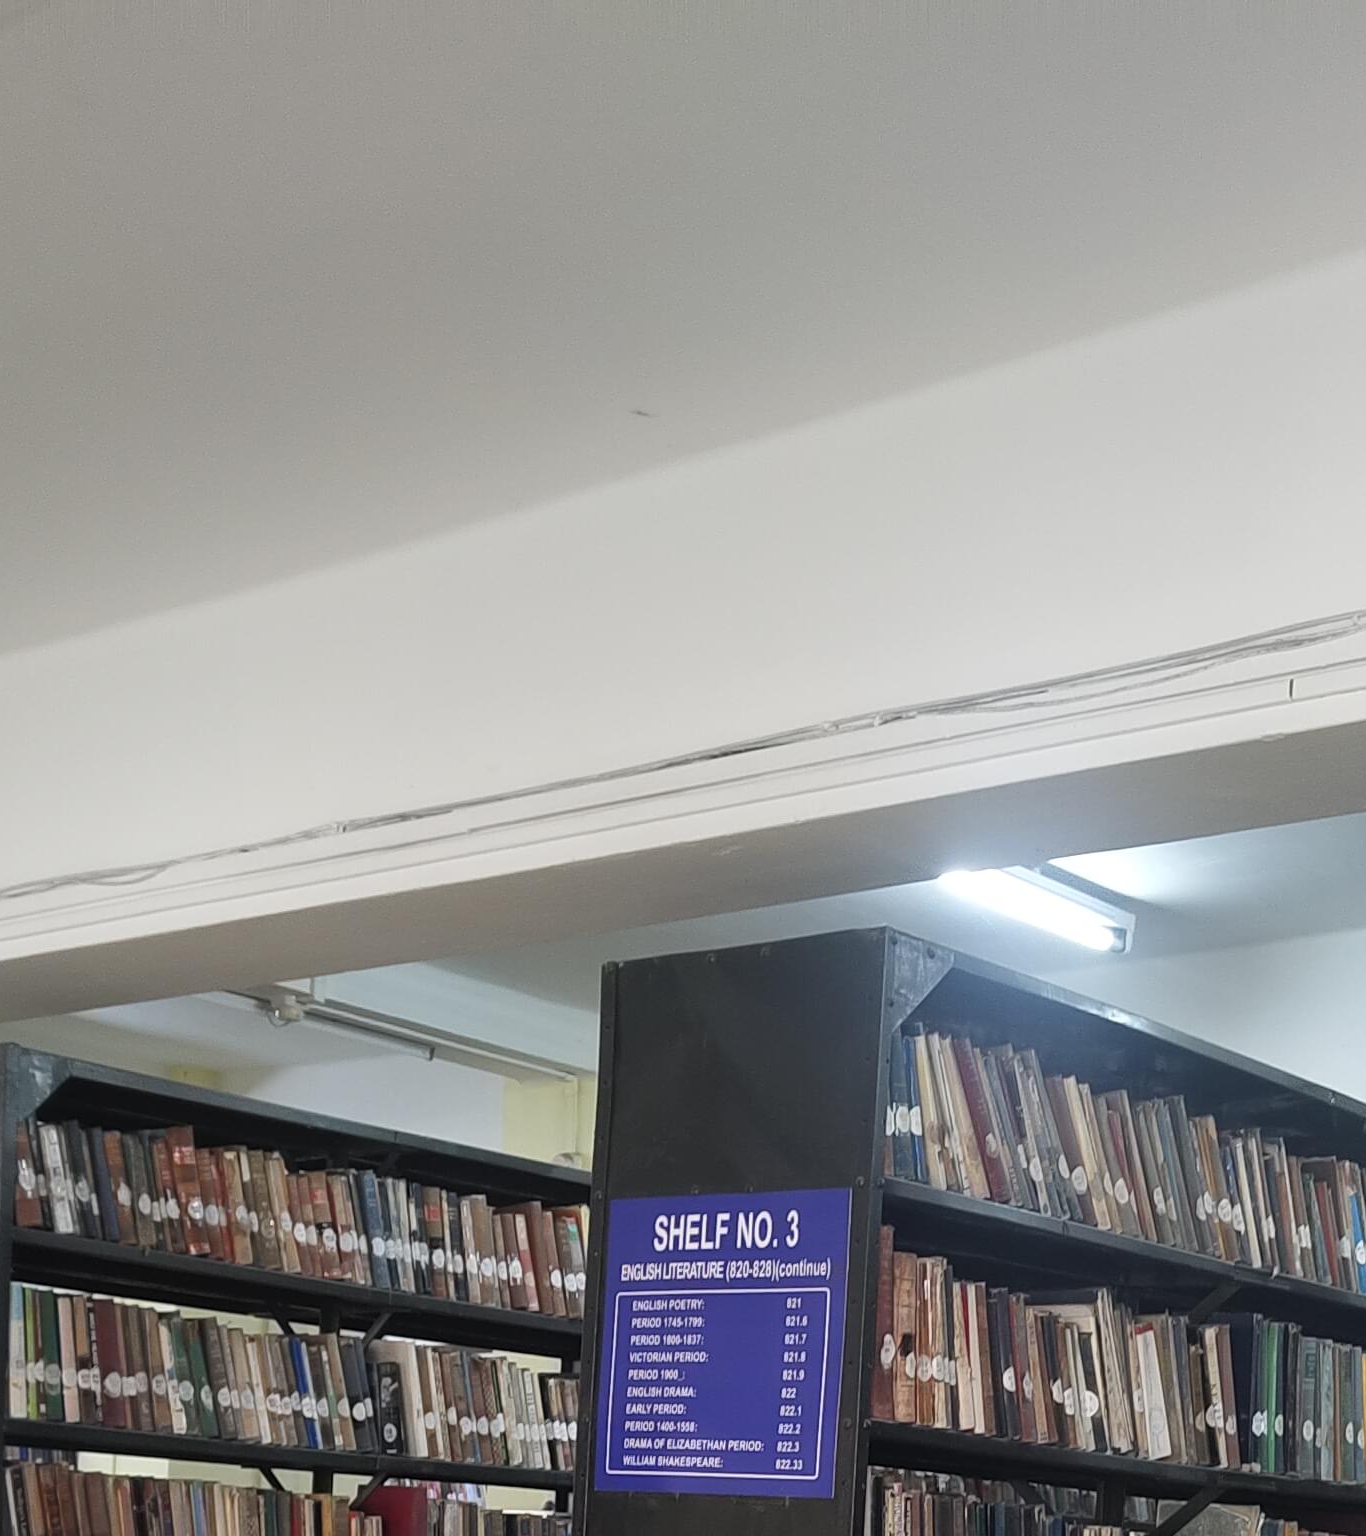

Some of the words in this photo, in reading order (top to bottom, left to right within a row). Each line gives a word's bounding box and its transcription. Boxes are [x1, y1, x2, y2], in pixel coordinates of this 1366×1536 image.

[653, 1212, 730, 1251] SHELF
[736, 1210, 777, 1248] NO.
[785, 1209, 799, 1247] 3
[621, 1262, 662, 1281] ENGLISH
[662, 1260, 724, 1279] LITERATURE
[632, 1299, 667, 1311] ENGLISH
[668, 1298, 705, 1310] POETRY:
[631, 1317, 662, 1328] PERIOD
[630, 1334, 660, 1345] PERIOD
[629, 1351, 672, 1362] VICTORIAN
[673, 1351, 709, 1362] PERIOD:
[628, 1369, 658, 1380] PERIOD
[626, 1386, 662, 1397] ENGLISH
[663, 1386, 697, 1397] DRAMA:
[625, 1403, 652, 1414] EARLY
[652, 1403, 687, 1414] PERIOD:
[624, 1420, 654, 1431] PERIOD
[623, 1437, 652, 1448] DRAMA
[653, 1437, 665, 1449] OF
[666, 1438, 726, 1450] ELIZABETHAN
[727, 1439, 764, 1451] PERIOD:
[623, 1454, 656, 1465] WILLIAM
[657, 1455, 724, 1467] SHAKESPEARE:
